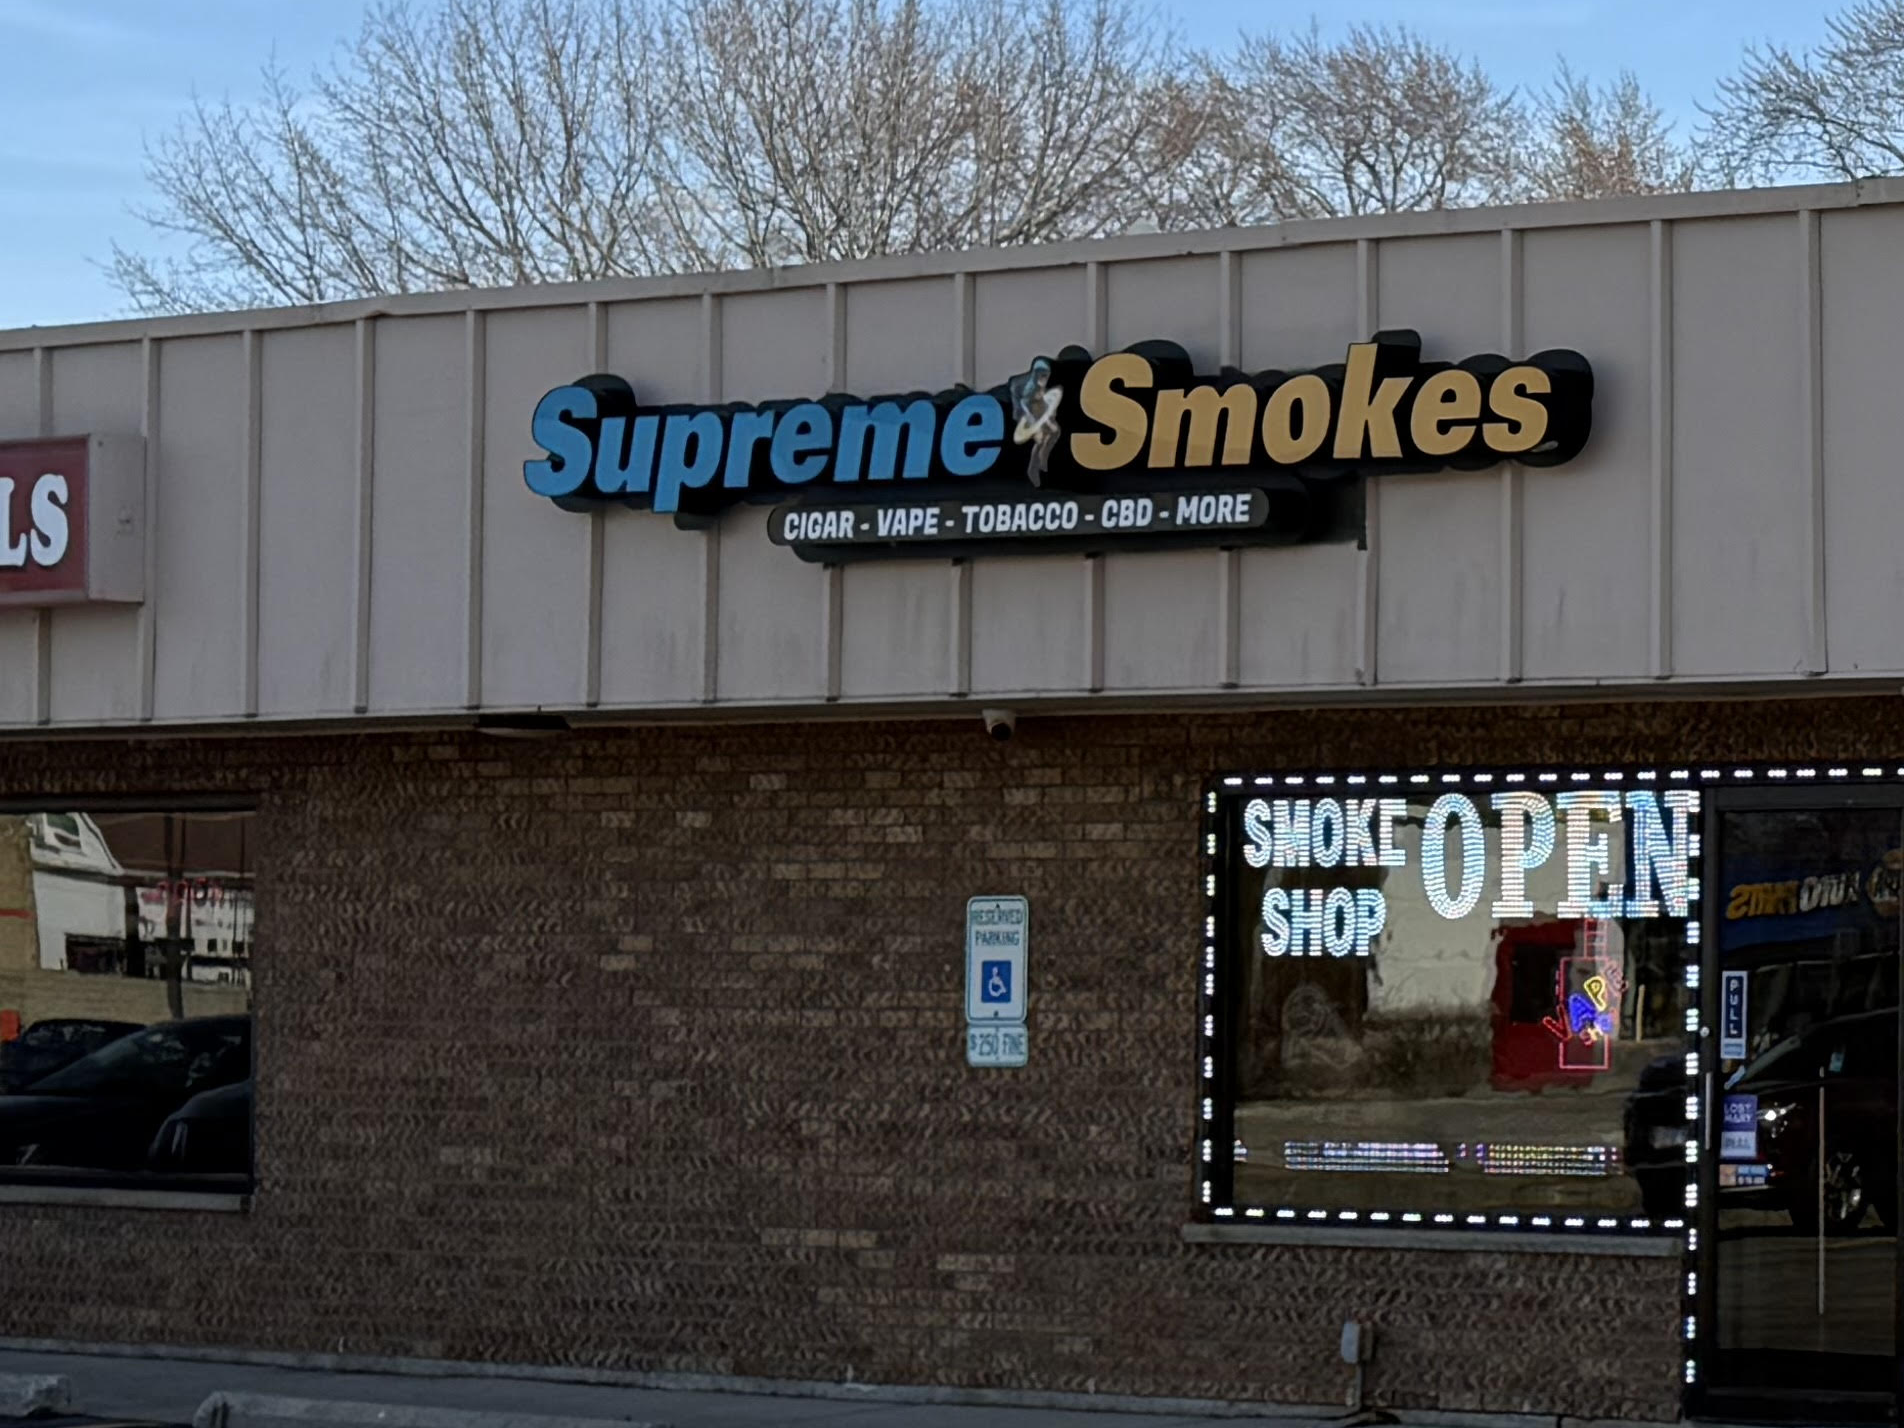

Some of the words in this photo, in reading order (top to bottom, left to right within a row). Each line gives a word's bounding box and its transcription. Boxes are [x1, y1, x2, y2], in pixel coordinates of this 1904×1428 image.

[523, 385, 1005, 513] Supreme
[1070, 343, 1552, 471] Smokes
[783, 511, 855, 541] CIGAR
[877, 507, 940, 537] VAPE
[961, 501, 1079, 534] TOBACCO
[1101, 497, 1154, 529] CBD
[1176, 493, 1252, 526] MORE
[1244, 799, 1407, 868] SMOKE
[1422, 790, 1699, 920] OPEN
[971, 909, 1023, 925] RESERVED
[975, 930, 1020, 946] PARKING
[1262, 888, 1387, 957] SHOP
[1729, 979, 1740, 1035] PULL
